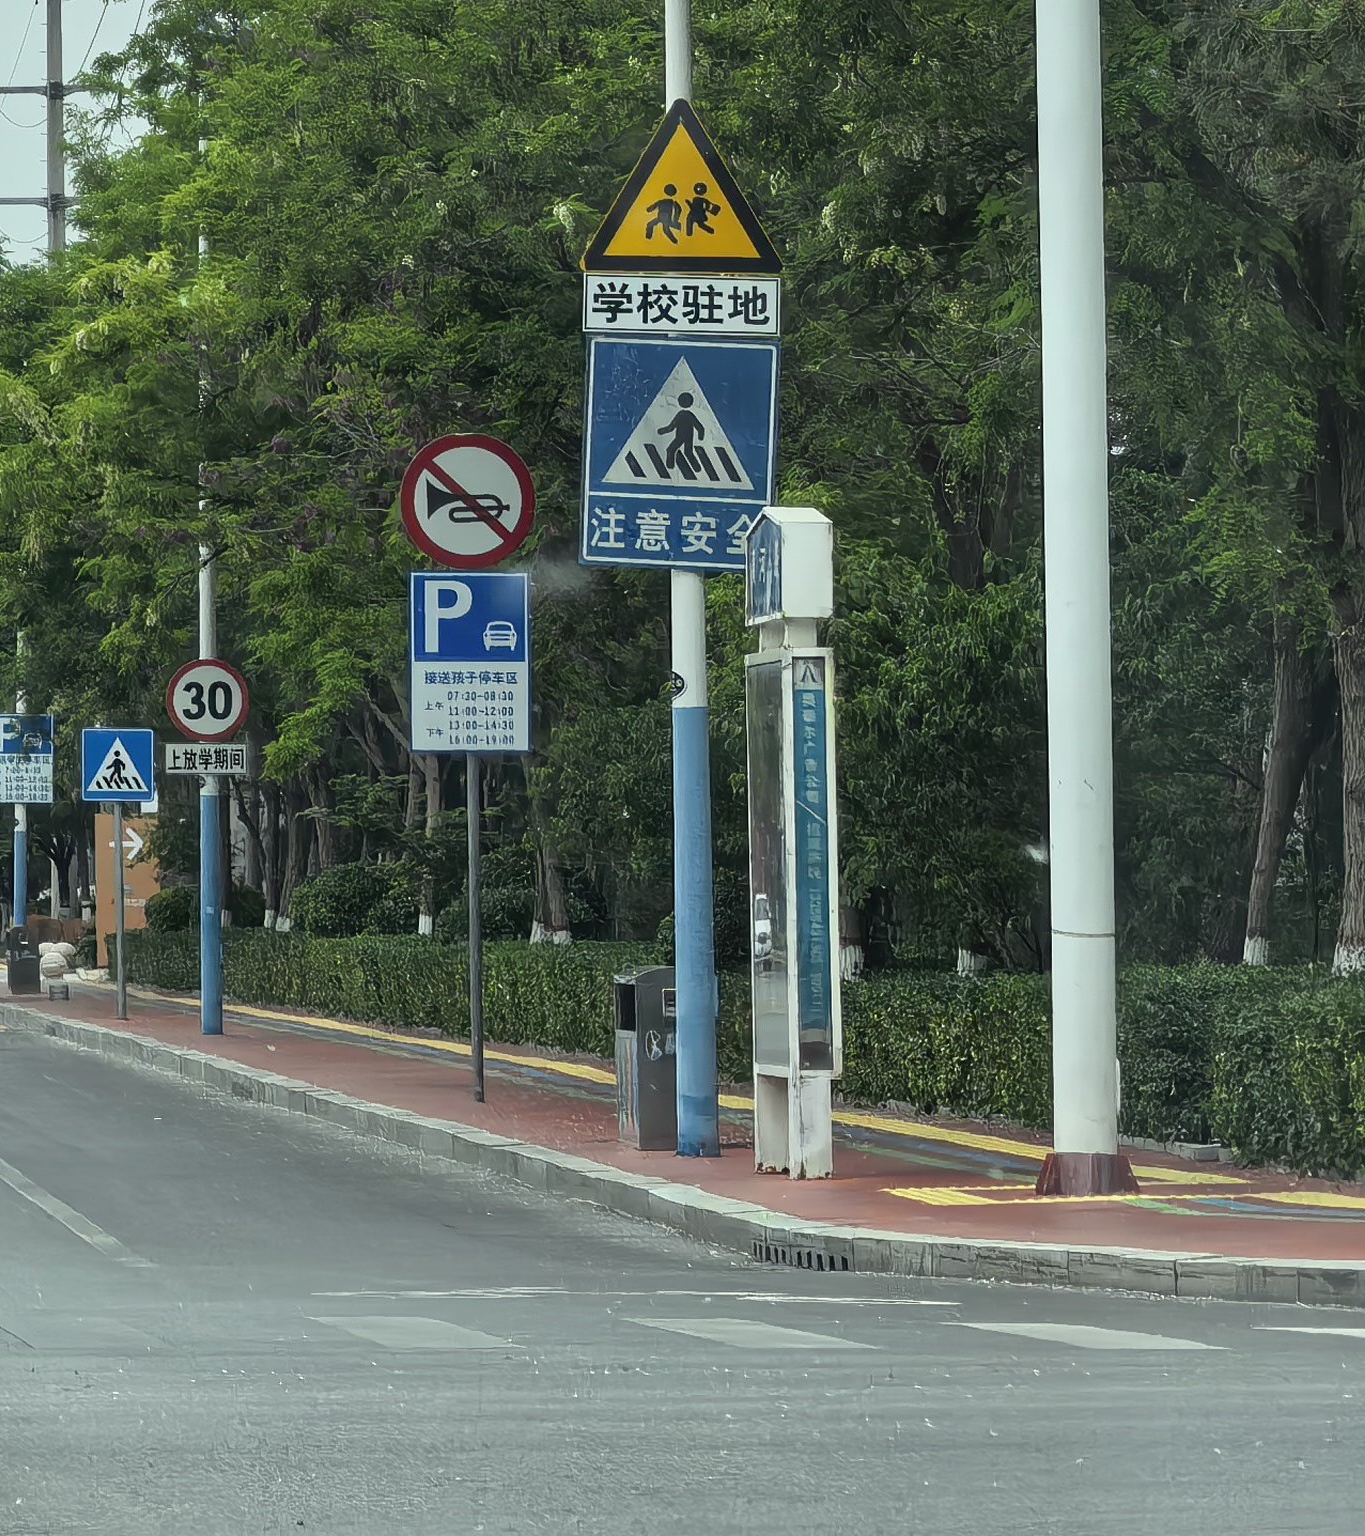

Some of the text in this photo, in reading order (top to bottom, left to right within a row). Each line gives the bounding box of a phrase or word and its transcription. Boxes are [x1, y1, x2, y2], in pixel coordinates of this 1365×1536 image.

[592, 281, 770, 326] 学校驻地
[590, 506, 752, 555] 注意安全
[424, 580, 473, 653] P
[424, 670, 518, 684] 接送孩子停车区
[182, 681, 233, 720] 30
[167, 748, 244, 771] 上放学期间
